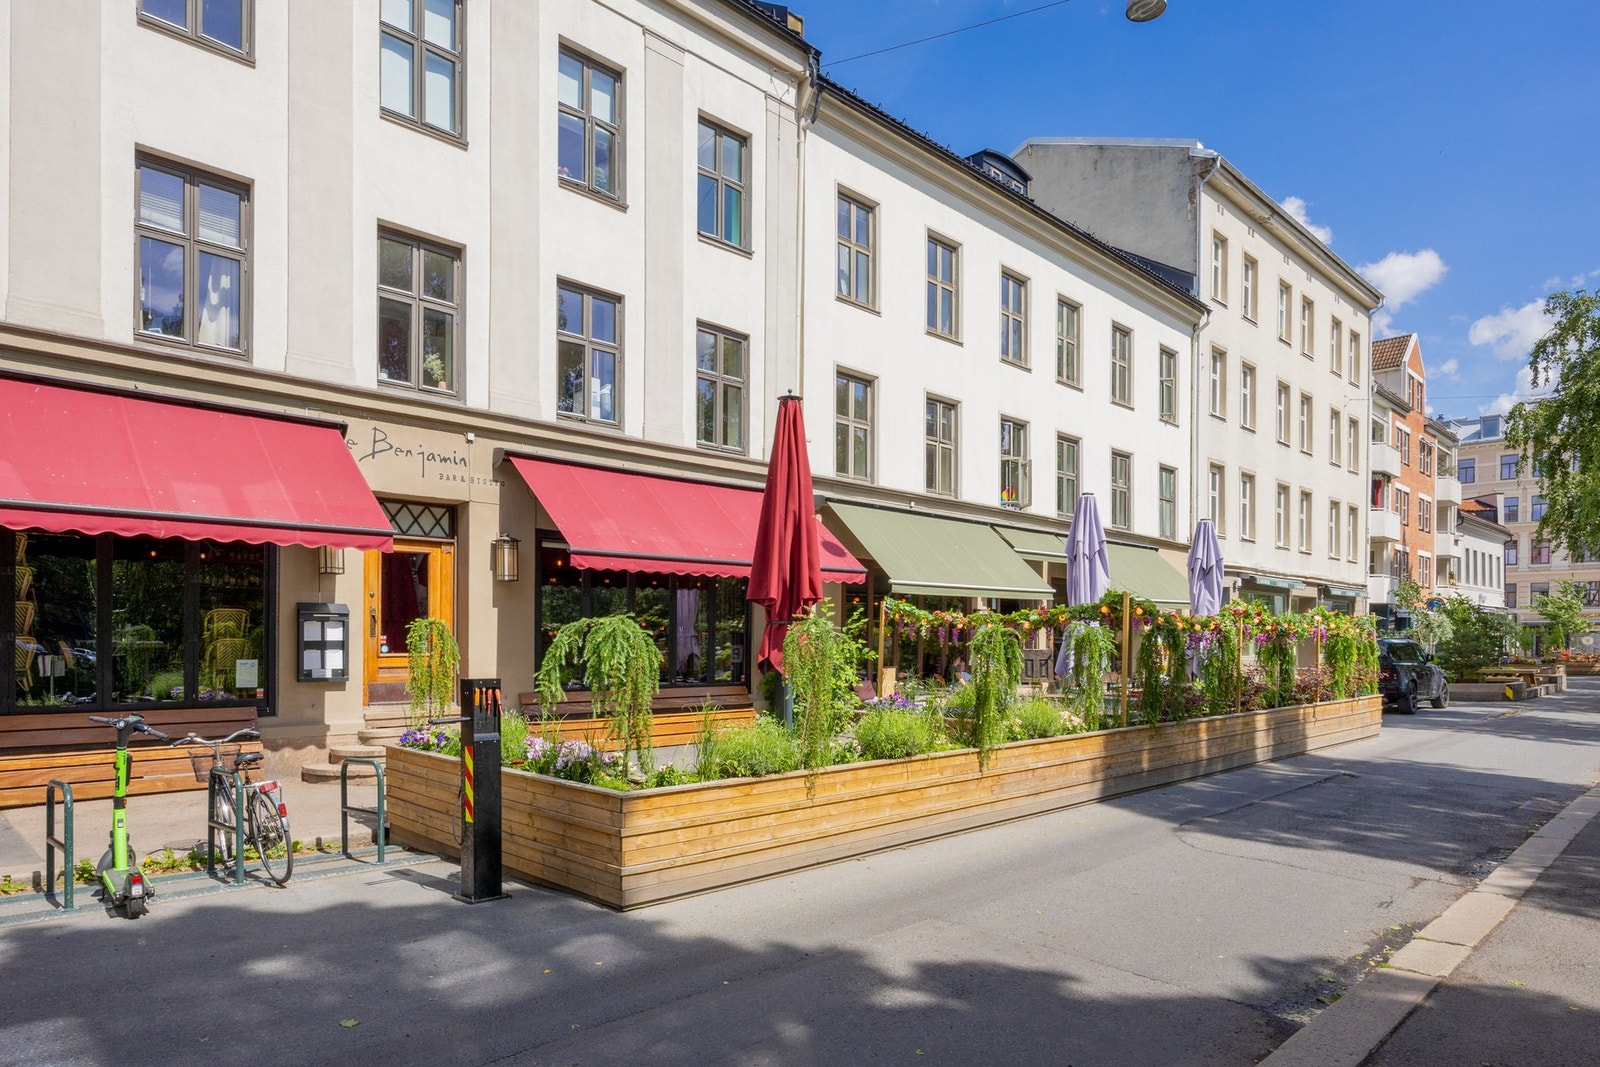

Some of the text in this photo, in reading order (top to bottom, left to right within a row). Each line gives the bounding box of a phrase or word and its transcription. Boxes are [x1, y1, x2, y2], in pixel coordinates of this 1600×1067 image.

[346, 426, 468, 478] e Benjamin
[439, 473, 457, 482] BAR
[460, 475, 466, 483] &
